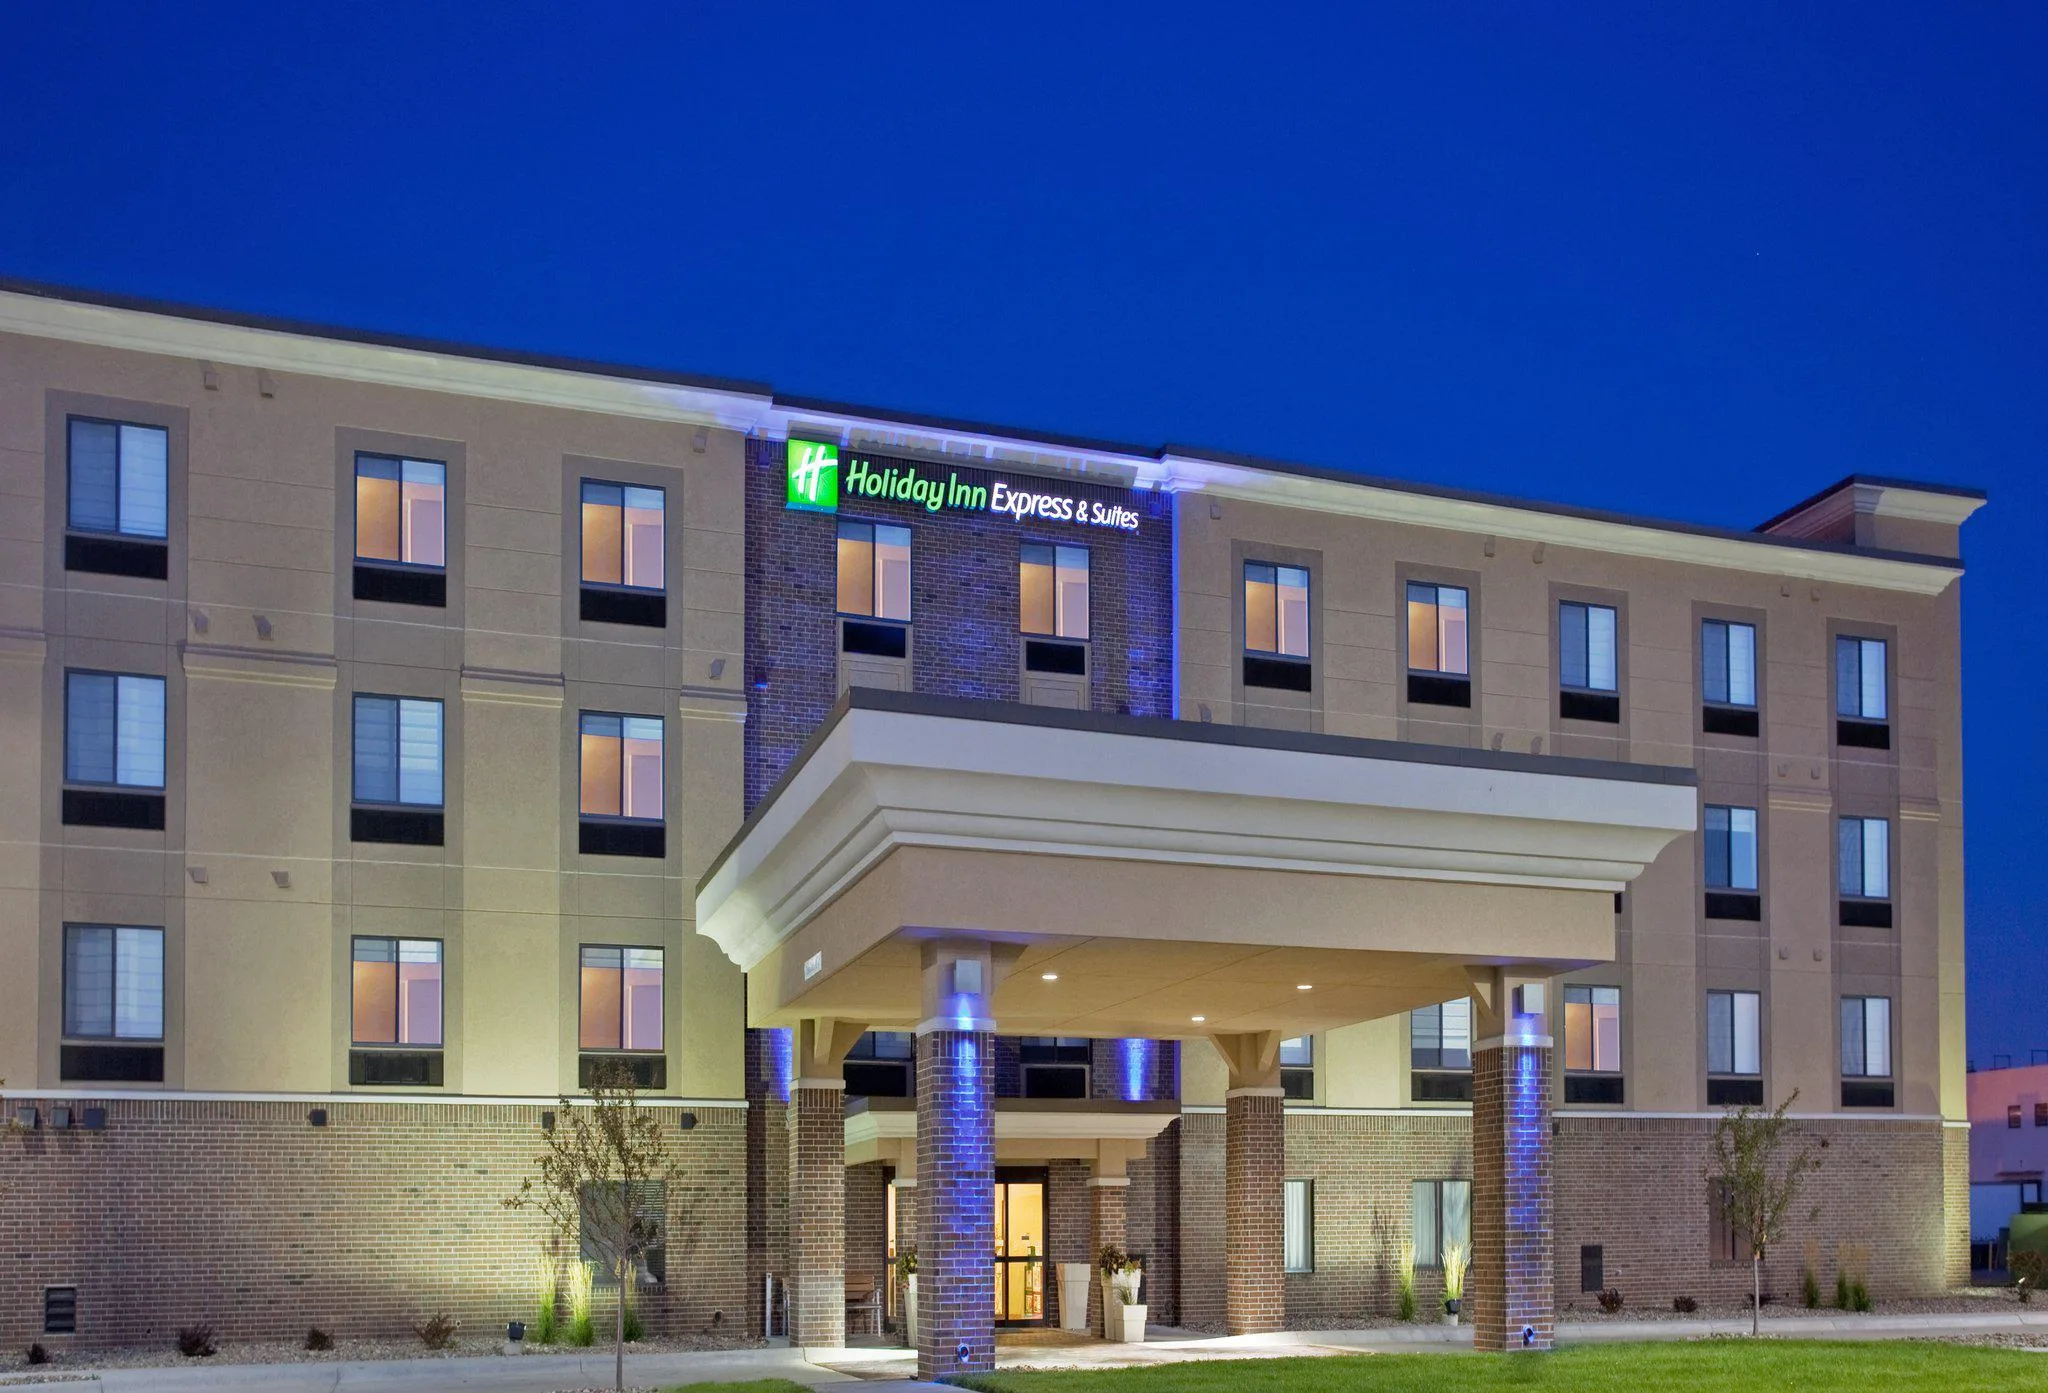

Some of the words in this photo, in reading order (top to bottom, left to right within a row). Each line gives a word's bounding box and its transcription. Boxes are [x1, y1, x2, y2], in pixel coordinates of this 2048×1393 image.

[845, 460, 945, 511] Holiday
[948, 472, 987, 508] Inn
[990, 483, 1073, 519] Express
[1076, 503, 1089, 522] &
[1091, 503, 1139, 528] Suites
